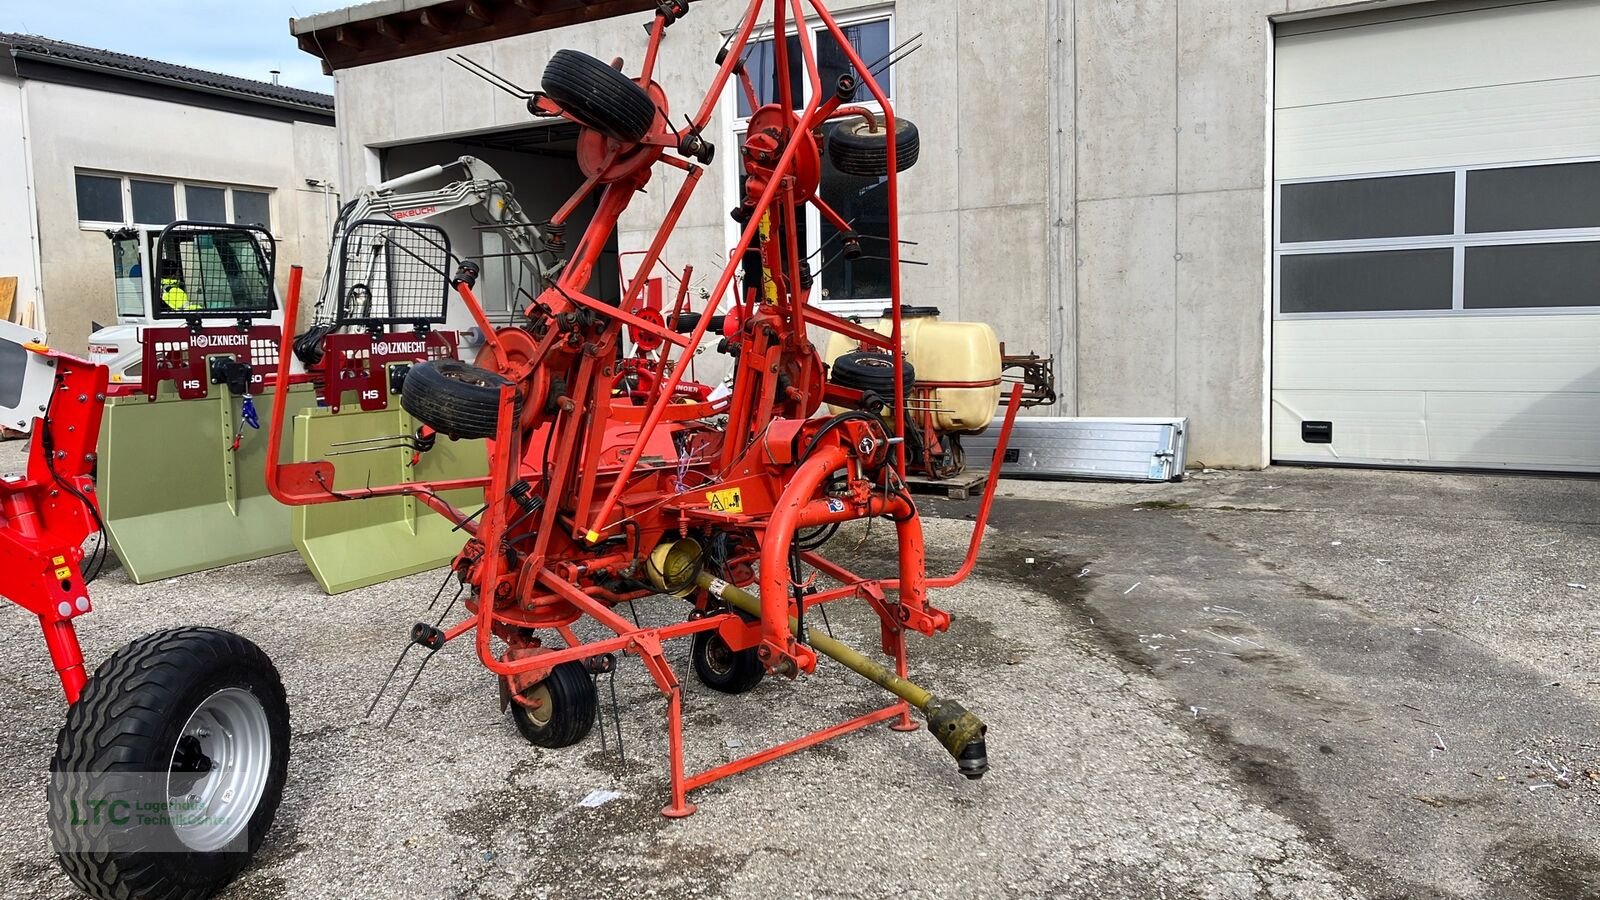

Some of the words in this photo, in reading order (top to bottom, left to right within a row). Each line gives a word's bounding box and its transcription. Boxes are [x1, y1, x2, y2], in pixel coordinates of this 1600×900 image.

[190, 335, 248, 348] HOLZKNECHT
[371, 341, 426, 355] HOLZKNECHT
[183, 380, 200, 389] HS
[362, 390, 379, 400] HS
